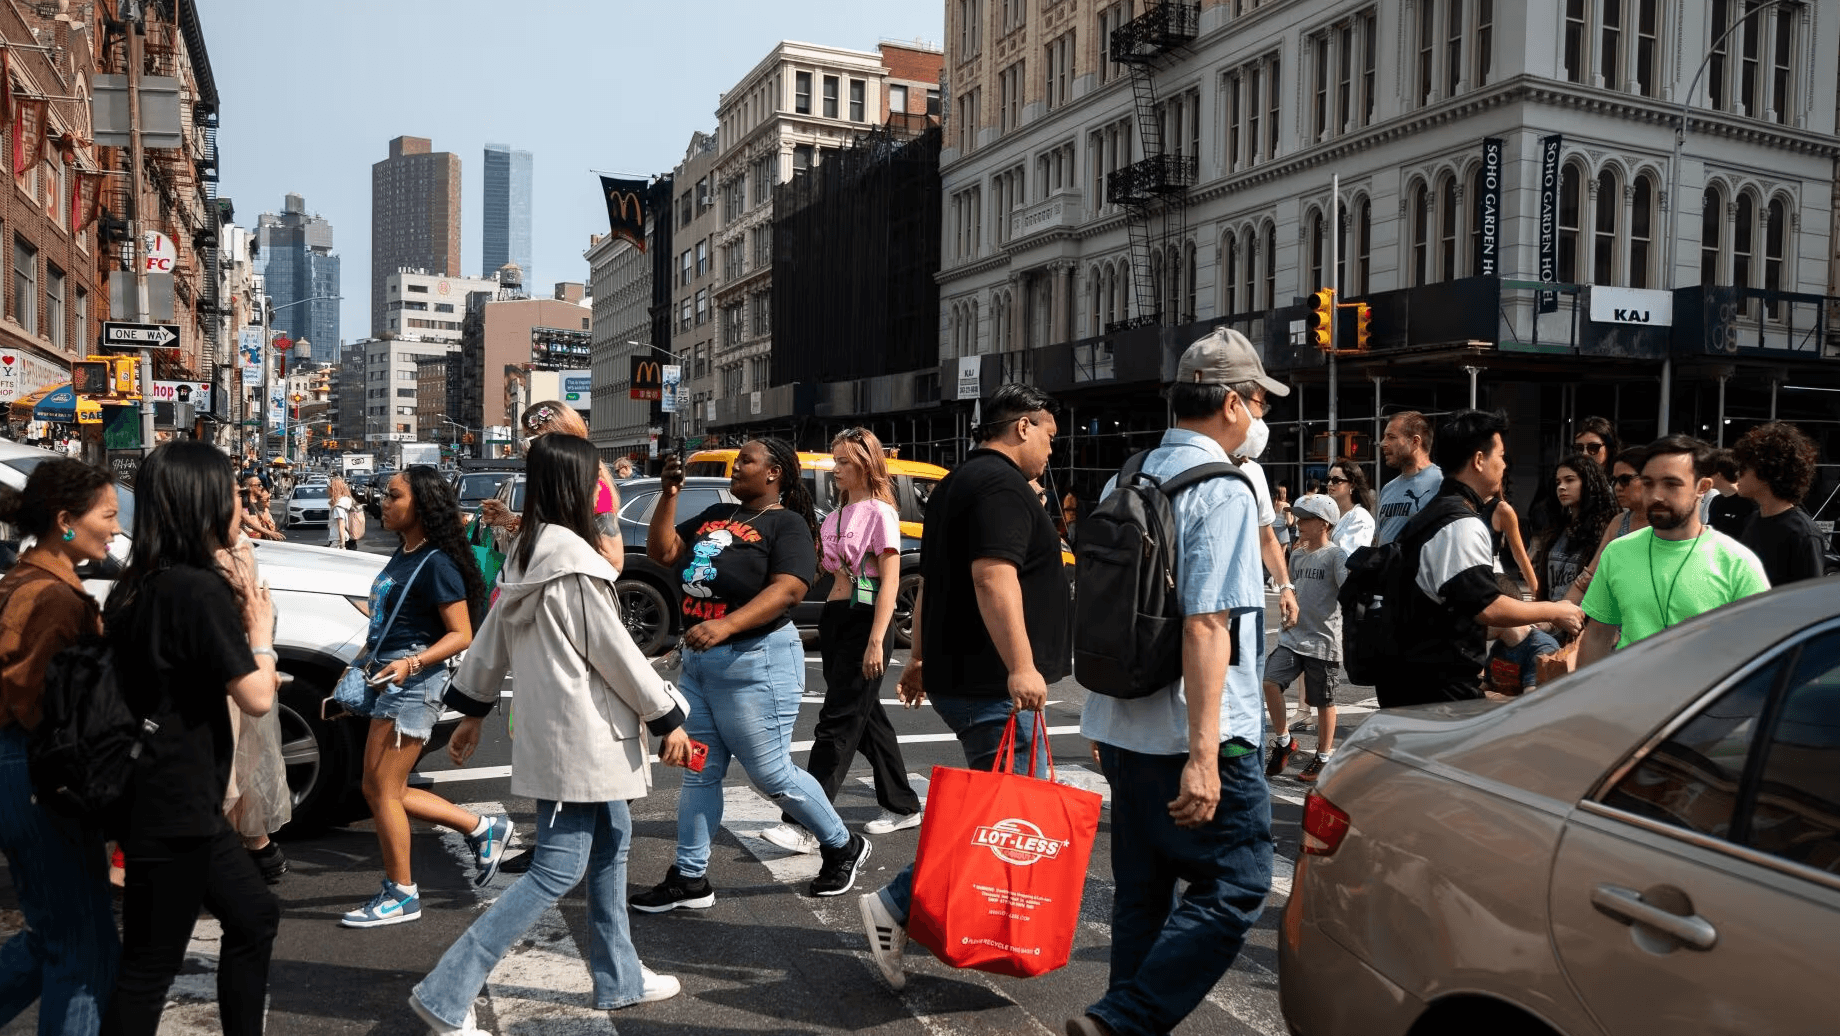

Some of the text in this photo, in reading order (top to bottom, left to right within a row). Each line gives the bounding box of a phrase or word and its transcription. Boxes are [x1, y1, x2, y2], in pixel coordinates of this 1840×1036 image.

[1486, 144, 1498, 190] SOHO
[1483, 193, 1496, 255] GARDEN
[1541, 142, 1557, 306] SOHO GARDEN HOEL
[147, 257, 170, 271] FC
[1614, 309, 1650, 323] KAJ
[115, 329, 169, 341] ONE WAY
[153, 382, 175, 401] hop
[677, 396, 689, 404] 25
[1379, 502, 1412, 518] PUMA
[1305, 568, 1325, 580] KLEIN
[682, 595, 727, 621] CARE
[983, 938, 1010, 952] RECYCLE
